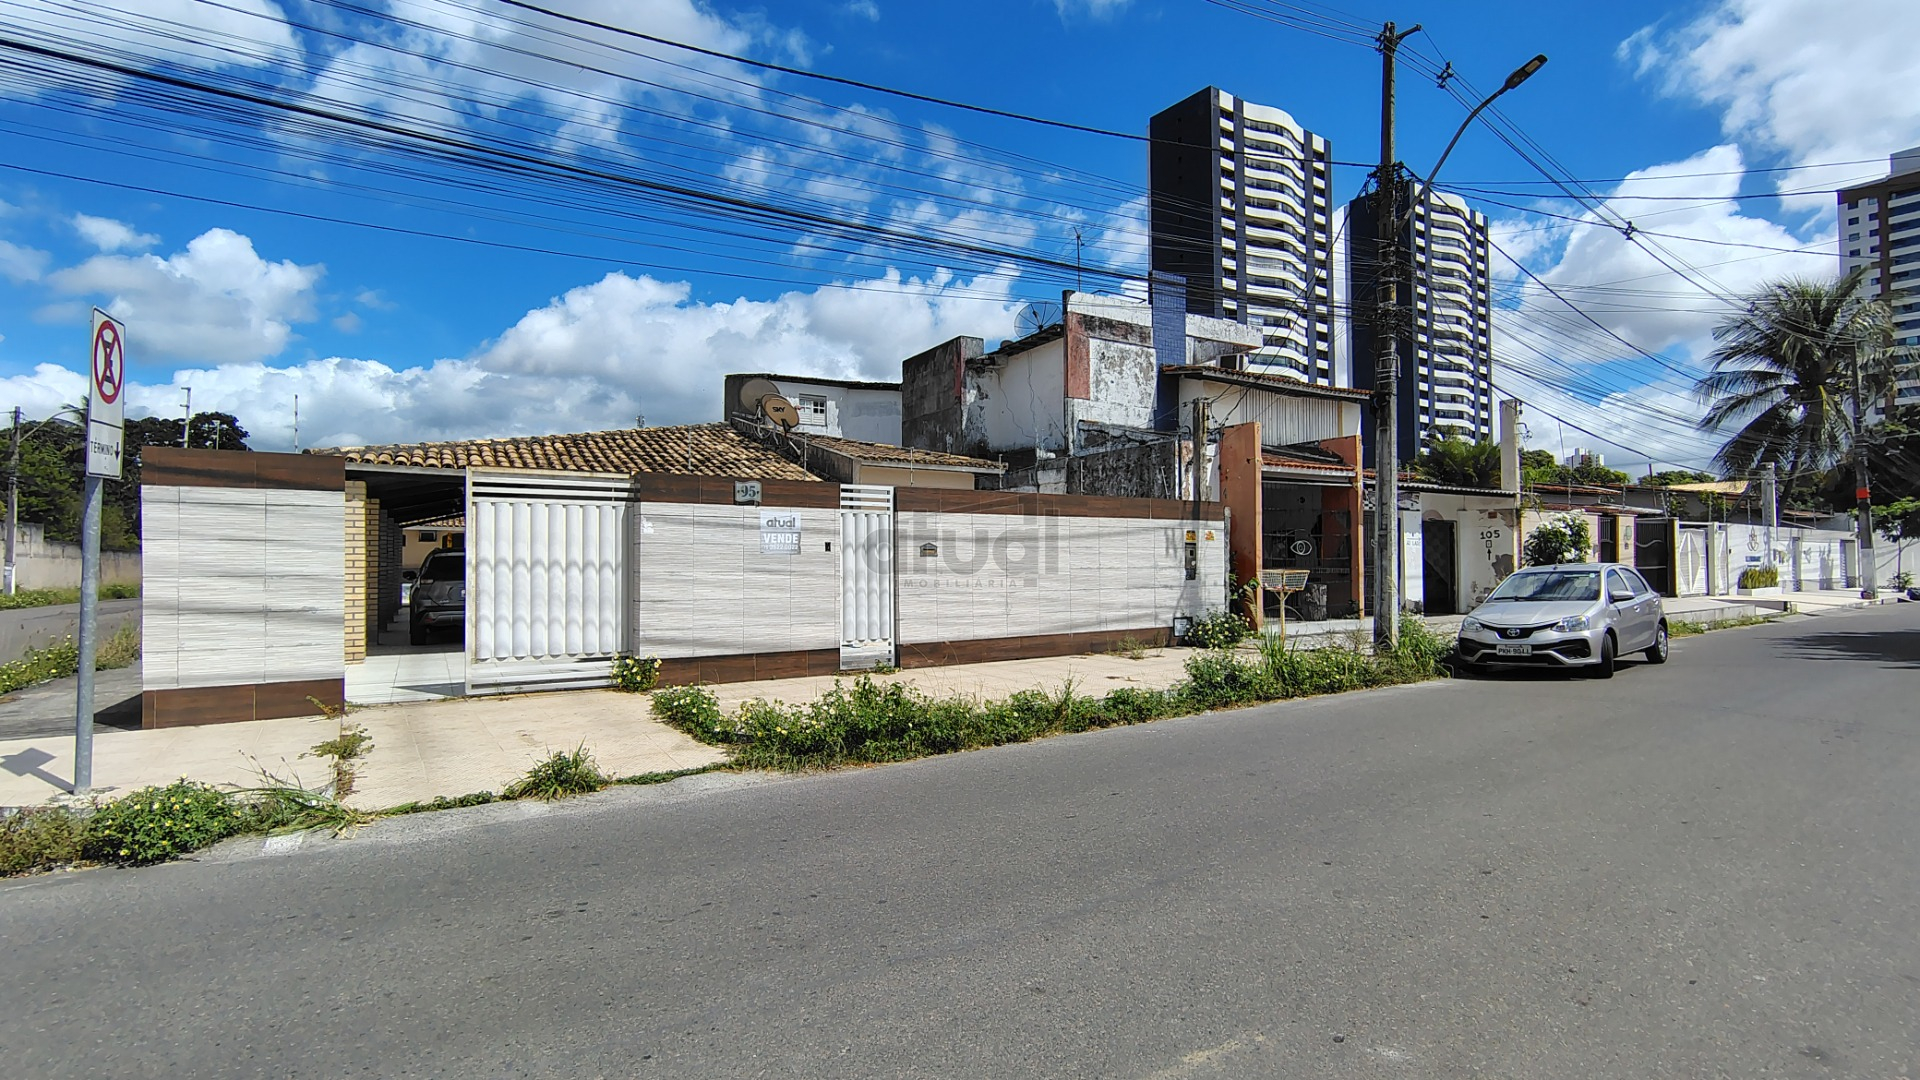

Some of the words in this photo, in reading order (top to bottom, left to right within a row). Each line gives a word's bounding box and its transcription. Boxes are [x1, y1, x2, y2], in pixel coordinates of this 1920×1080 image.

[741, 485, 757, 498] 95
[766, 517, 796, 528] atual
[763, 533, 799, 543] VENDE
[1480, 529, 1500, 540] 105
